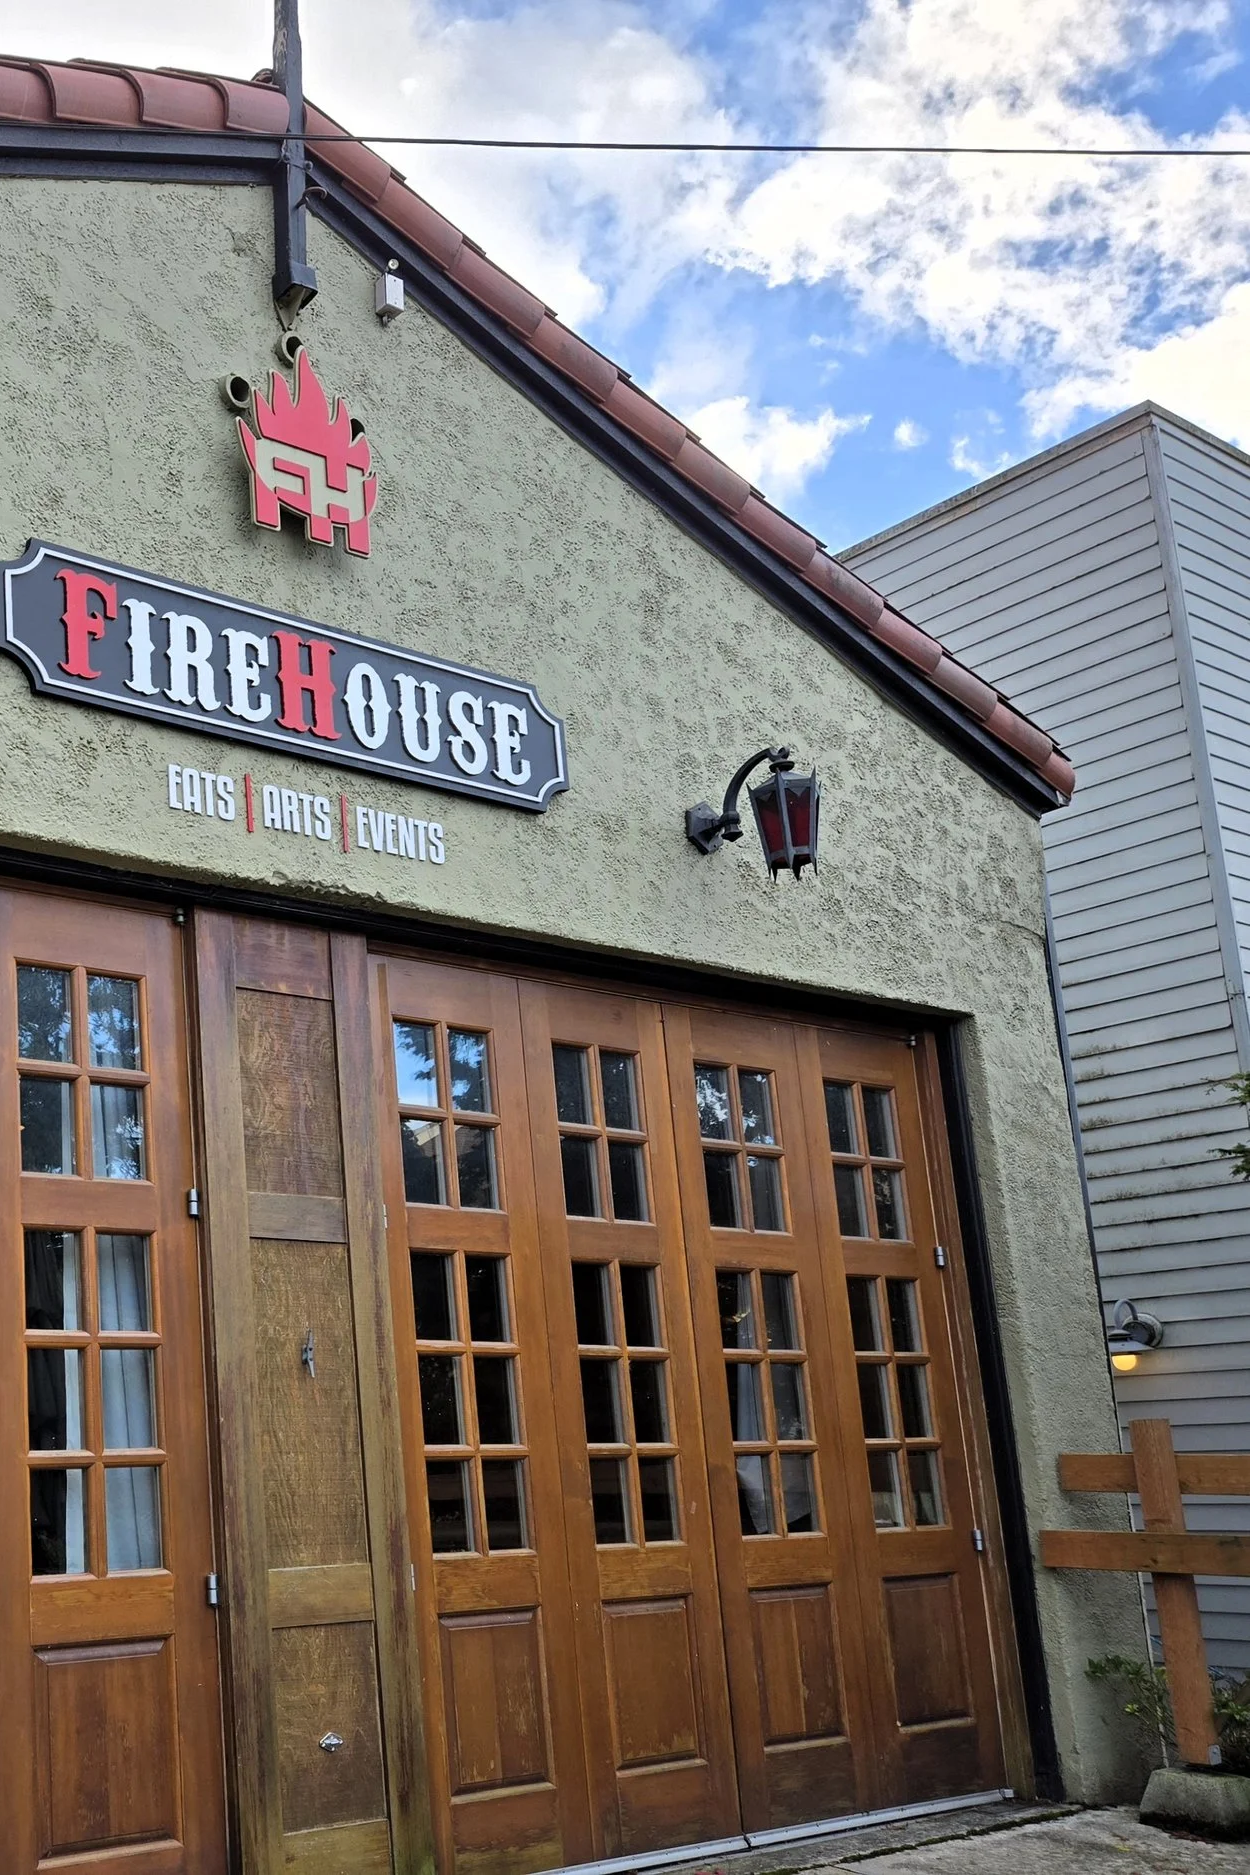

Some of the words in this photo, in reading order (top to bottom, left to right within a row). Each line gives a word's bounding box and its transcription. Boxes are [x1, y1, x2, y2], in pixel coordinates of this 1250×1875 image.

[55, 568, 532, 786] FIREHOUSE
[167, 763, 236, 821] EATS
[262, 784, 332, 841] ARTS
[355, 805, 446, 865] EVENTS
